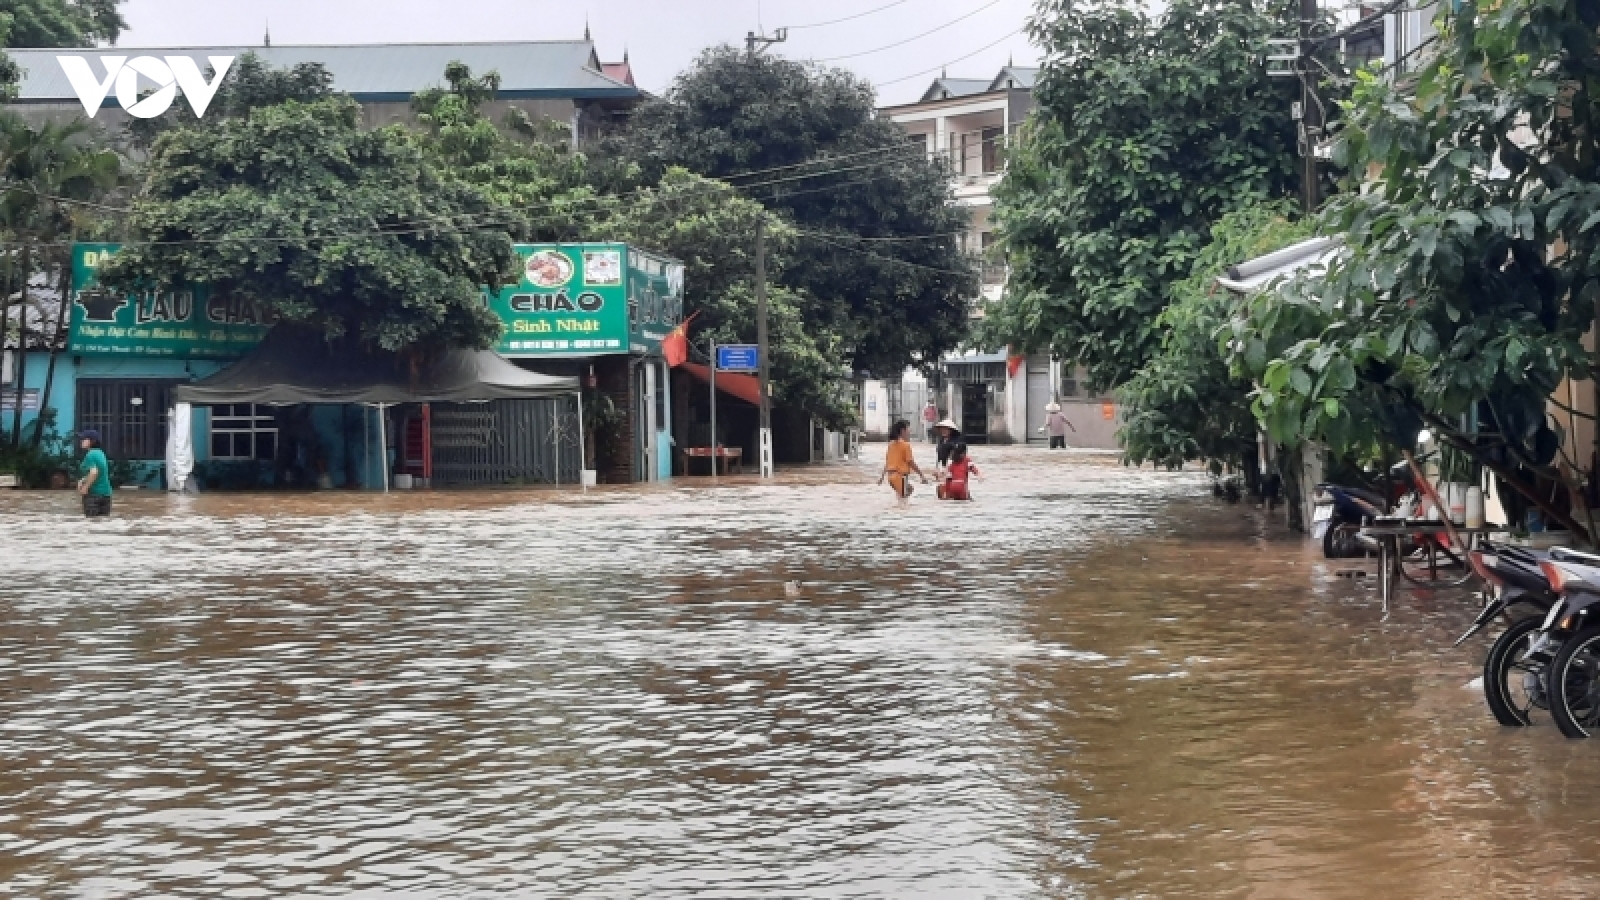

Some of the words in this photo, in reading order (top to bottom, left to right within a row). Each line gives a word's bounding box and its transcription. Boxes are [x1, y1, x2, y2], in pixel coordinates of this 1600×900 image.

[509, 288, 604, 312] CHÁO
[512, 319, 551, 333] Sinh
[555, 318, 600, 334] Nhật
